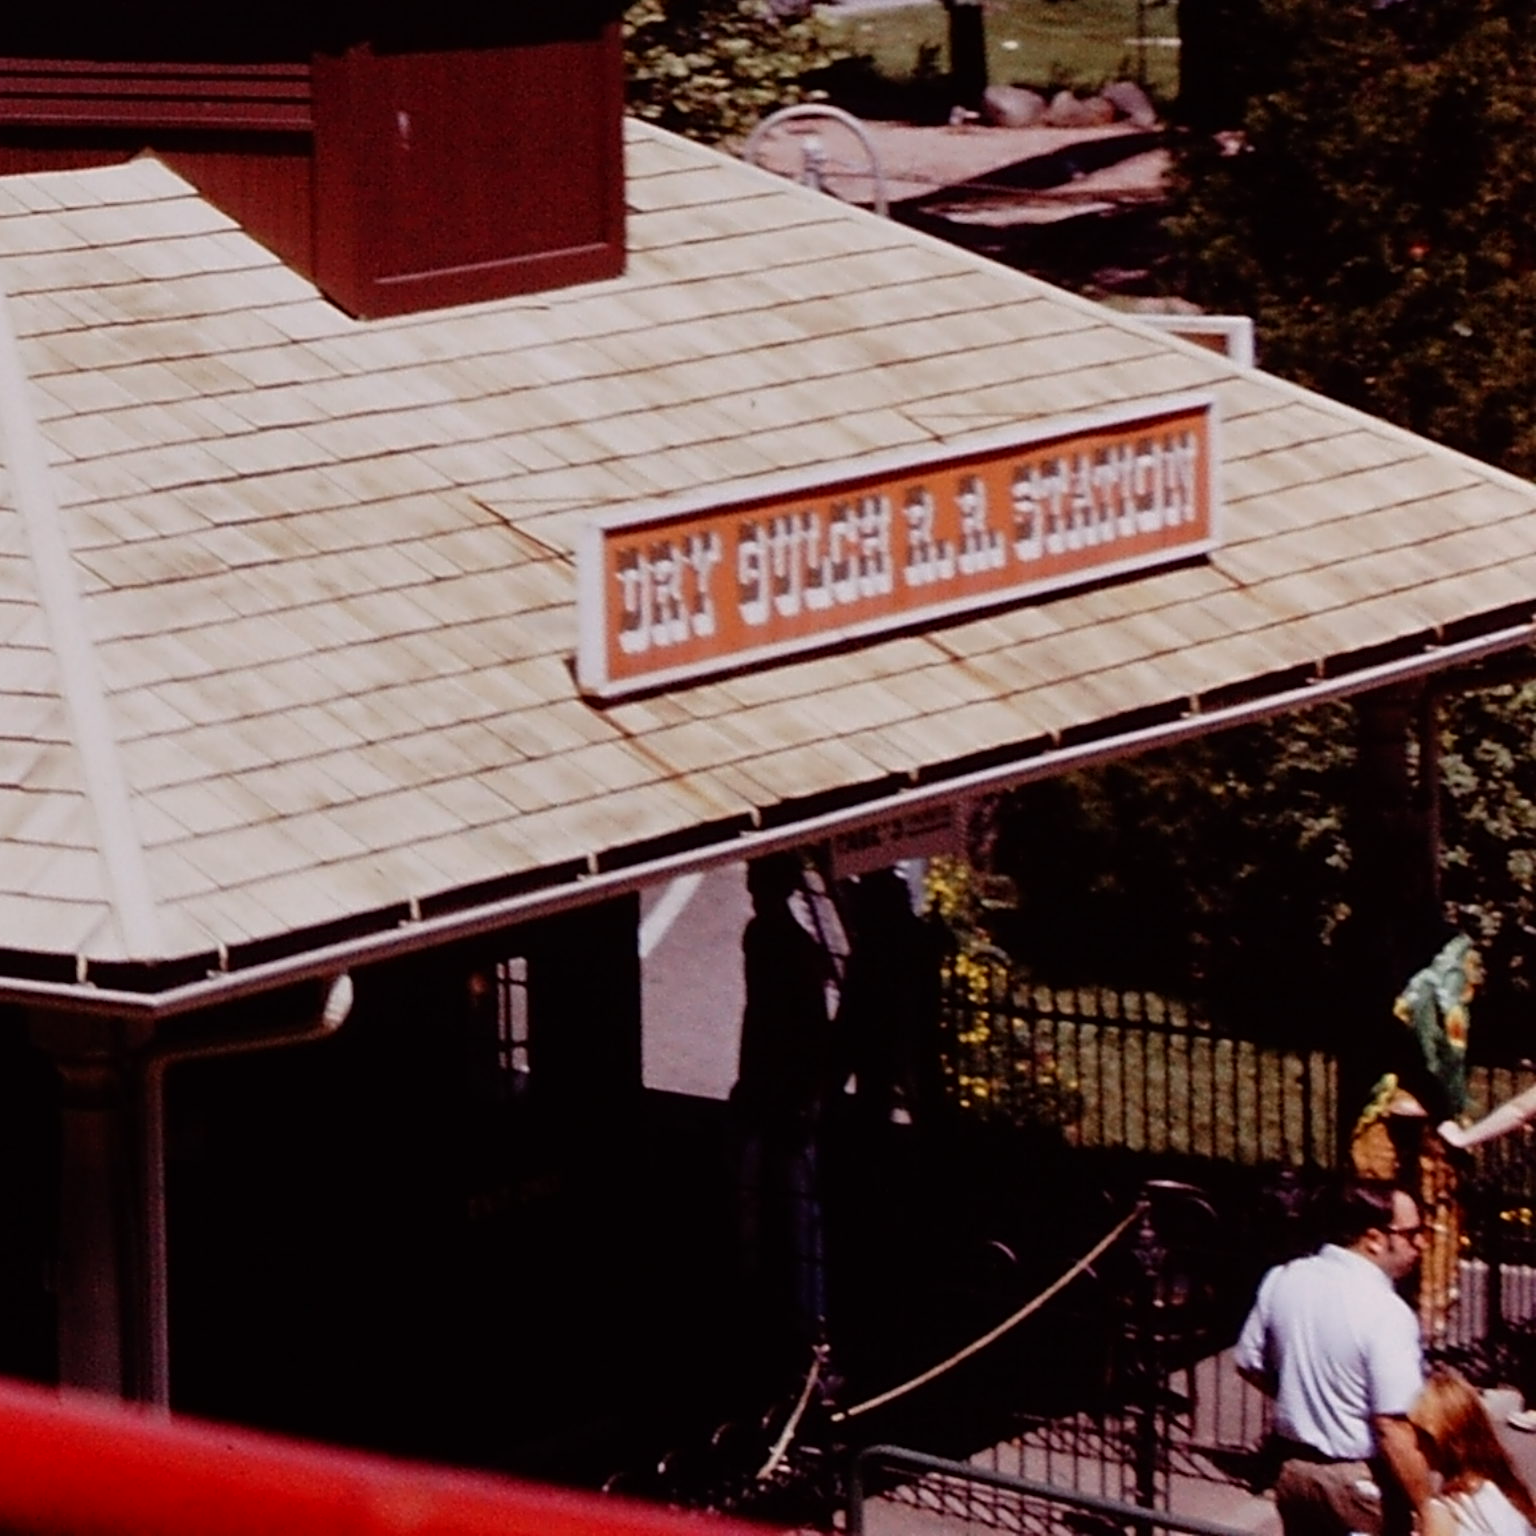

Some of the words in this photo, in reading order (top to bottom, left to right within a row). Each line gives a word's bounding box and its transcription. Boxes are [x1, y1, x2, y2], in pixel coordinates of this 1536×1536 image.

[618, 530, 721, 654] DRY
[737, 494, 893, 625] GULCH
[1011, 432, 1196, 561] STATION
